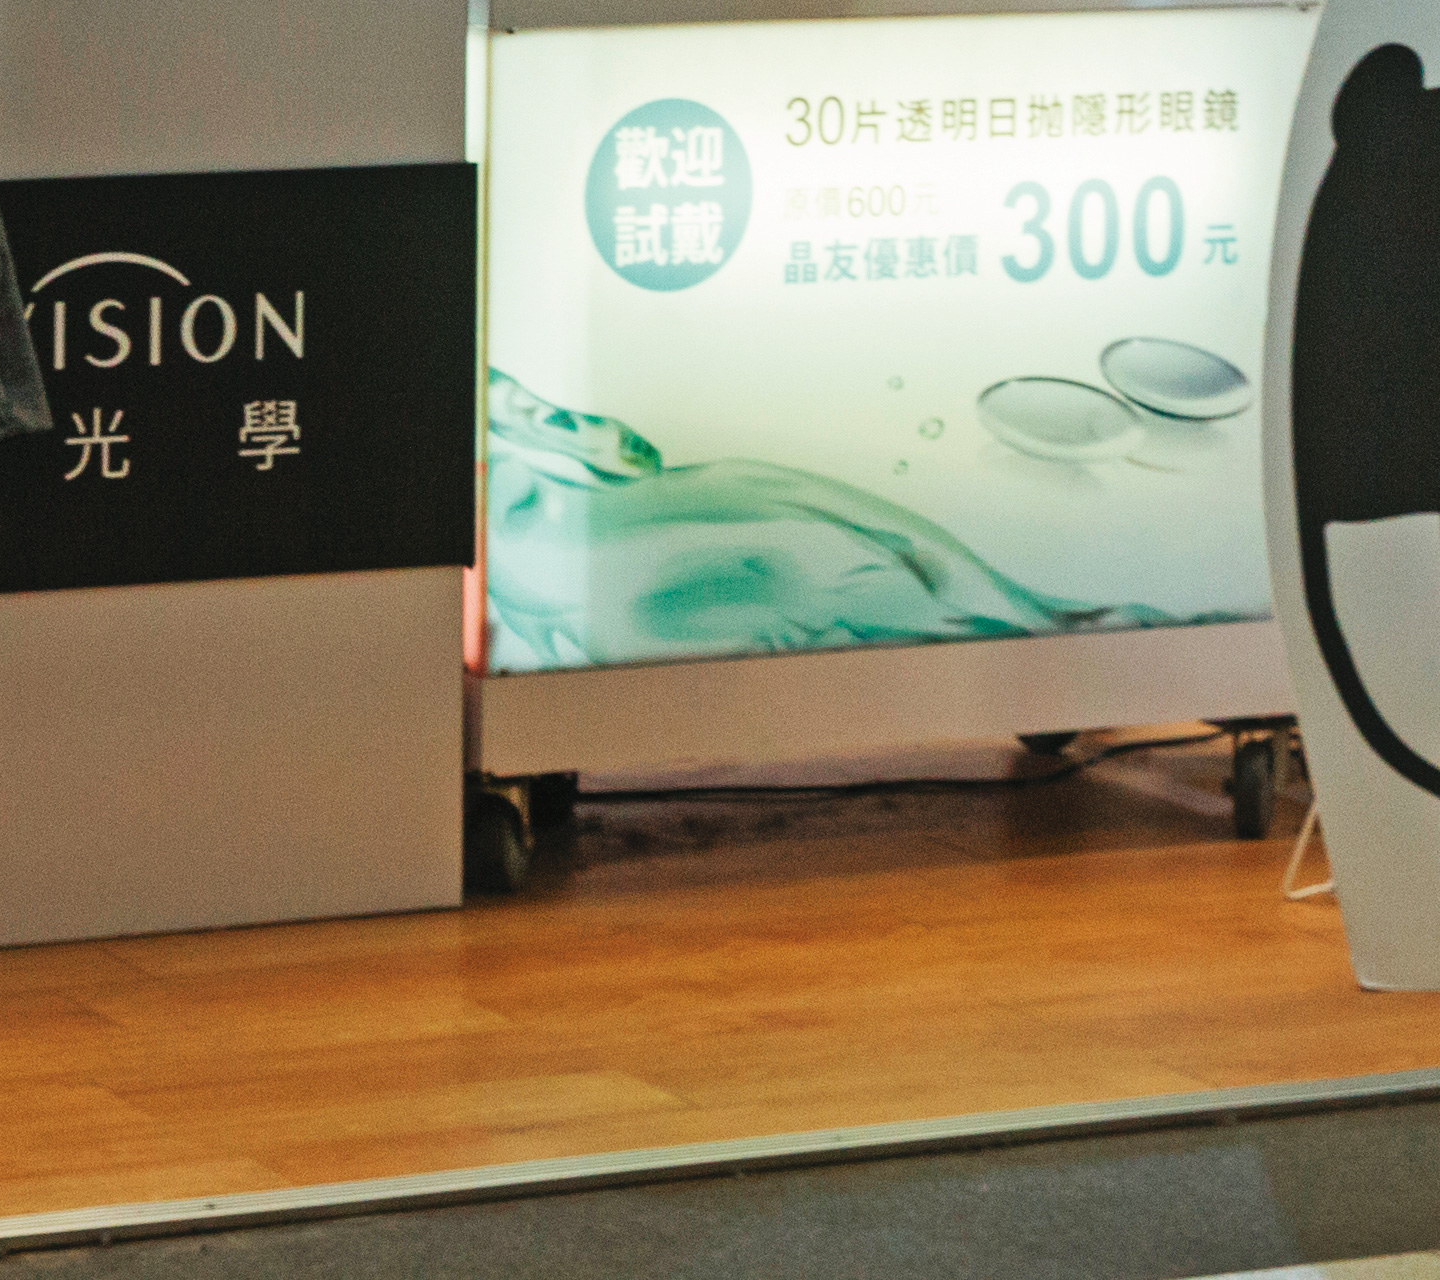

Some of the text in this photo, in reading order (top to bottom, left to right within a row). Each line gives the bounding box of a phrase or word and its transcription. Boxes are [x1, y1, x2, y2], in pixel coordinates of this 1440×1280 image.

[614, 125, 727, 190] 歡迎
[614, 201, 727, 269] 試戴
[782, 233, 981, 286] 晶友優惠價
